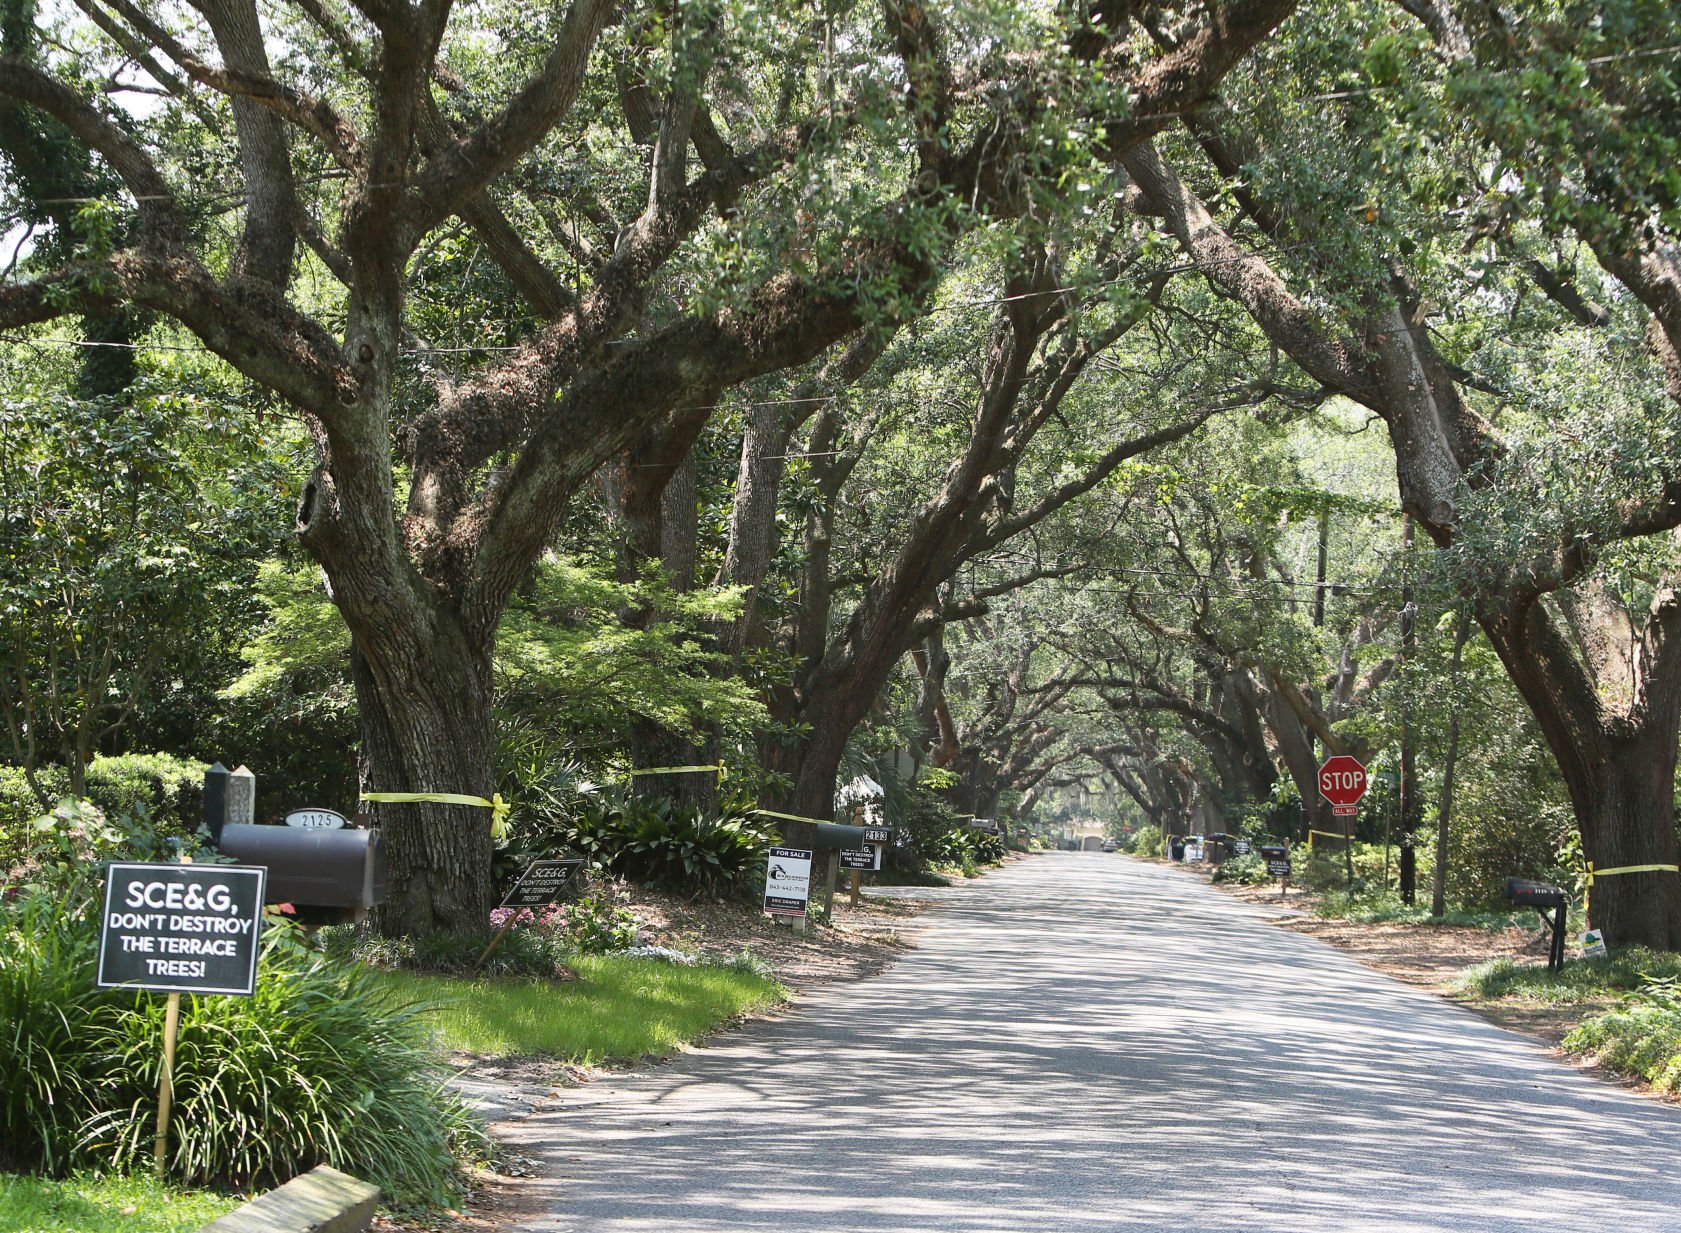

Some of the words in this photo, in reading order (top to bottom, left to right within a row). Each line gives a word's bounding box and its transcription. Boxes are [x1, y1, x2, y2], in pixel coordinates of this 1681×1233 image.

[1322, 771, 1363, 791] STOP
[302, 814, 332, 827] 2125
[865, 830, 888, 841] 2133
[531, 867, 568, 878] SCE&G,
[125, 880, 239, 916] SCE&G,
[109, 912, 167, 931] DON'T
[169, 915, 253, 935] DESTROY
[120, 935, 155, 953] THE
[157, 936, 237, 957] TERRACE
[146, 959, 205, 978] TREES!
